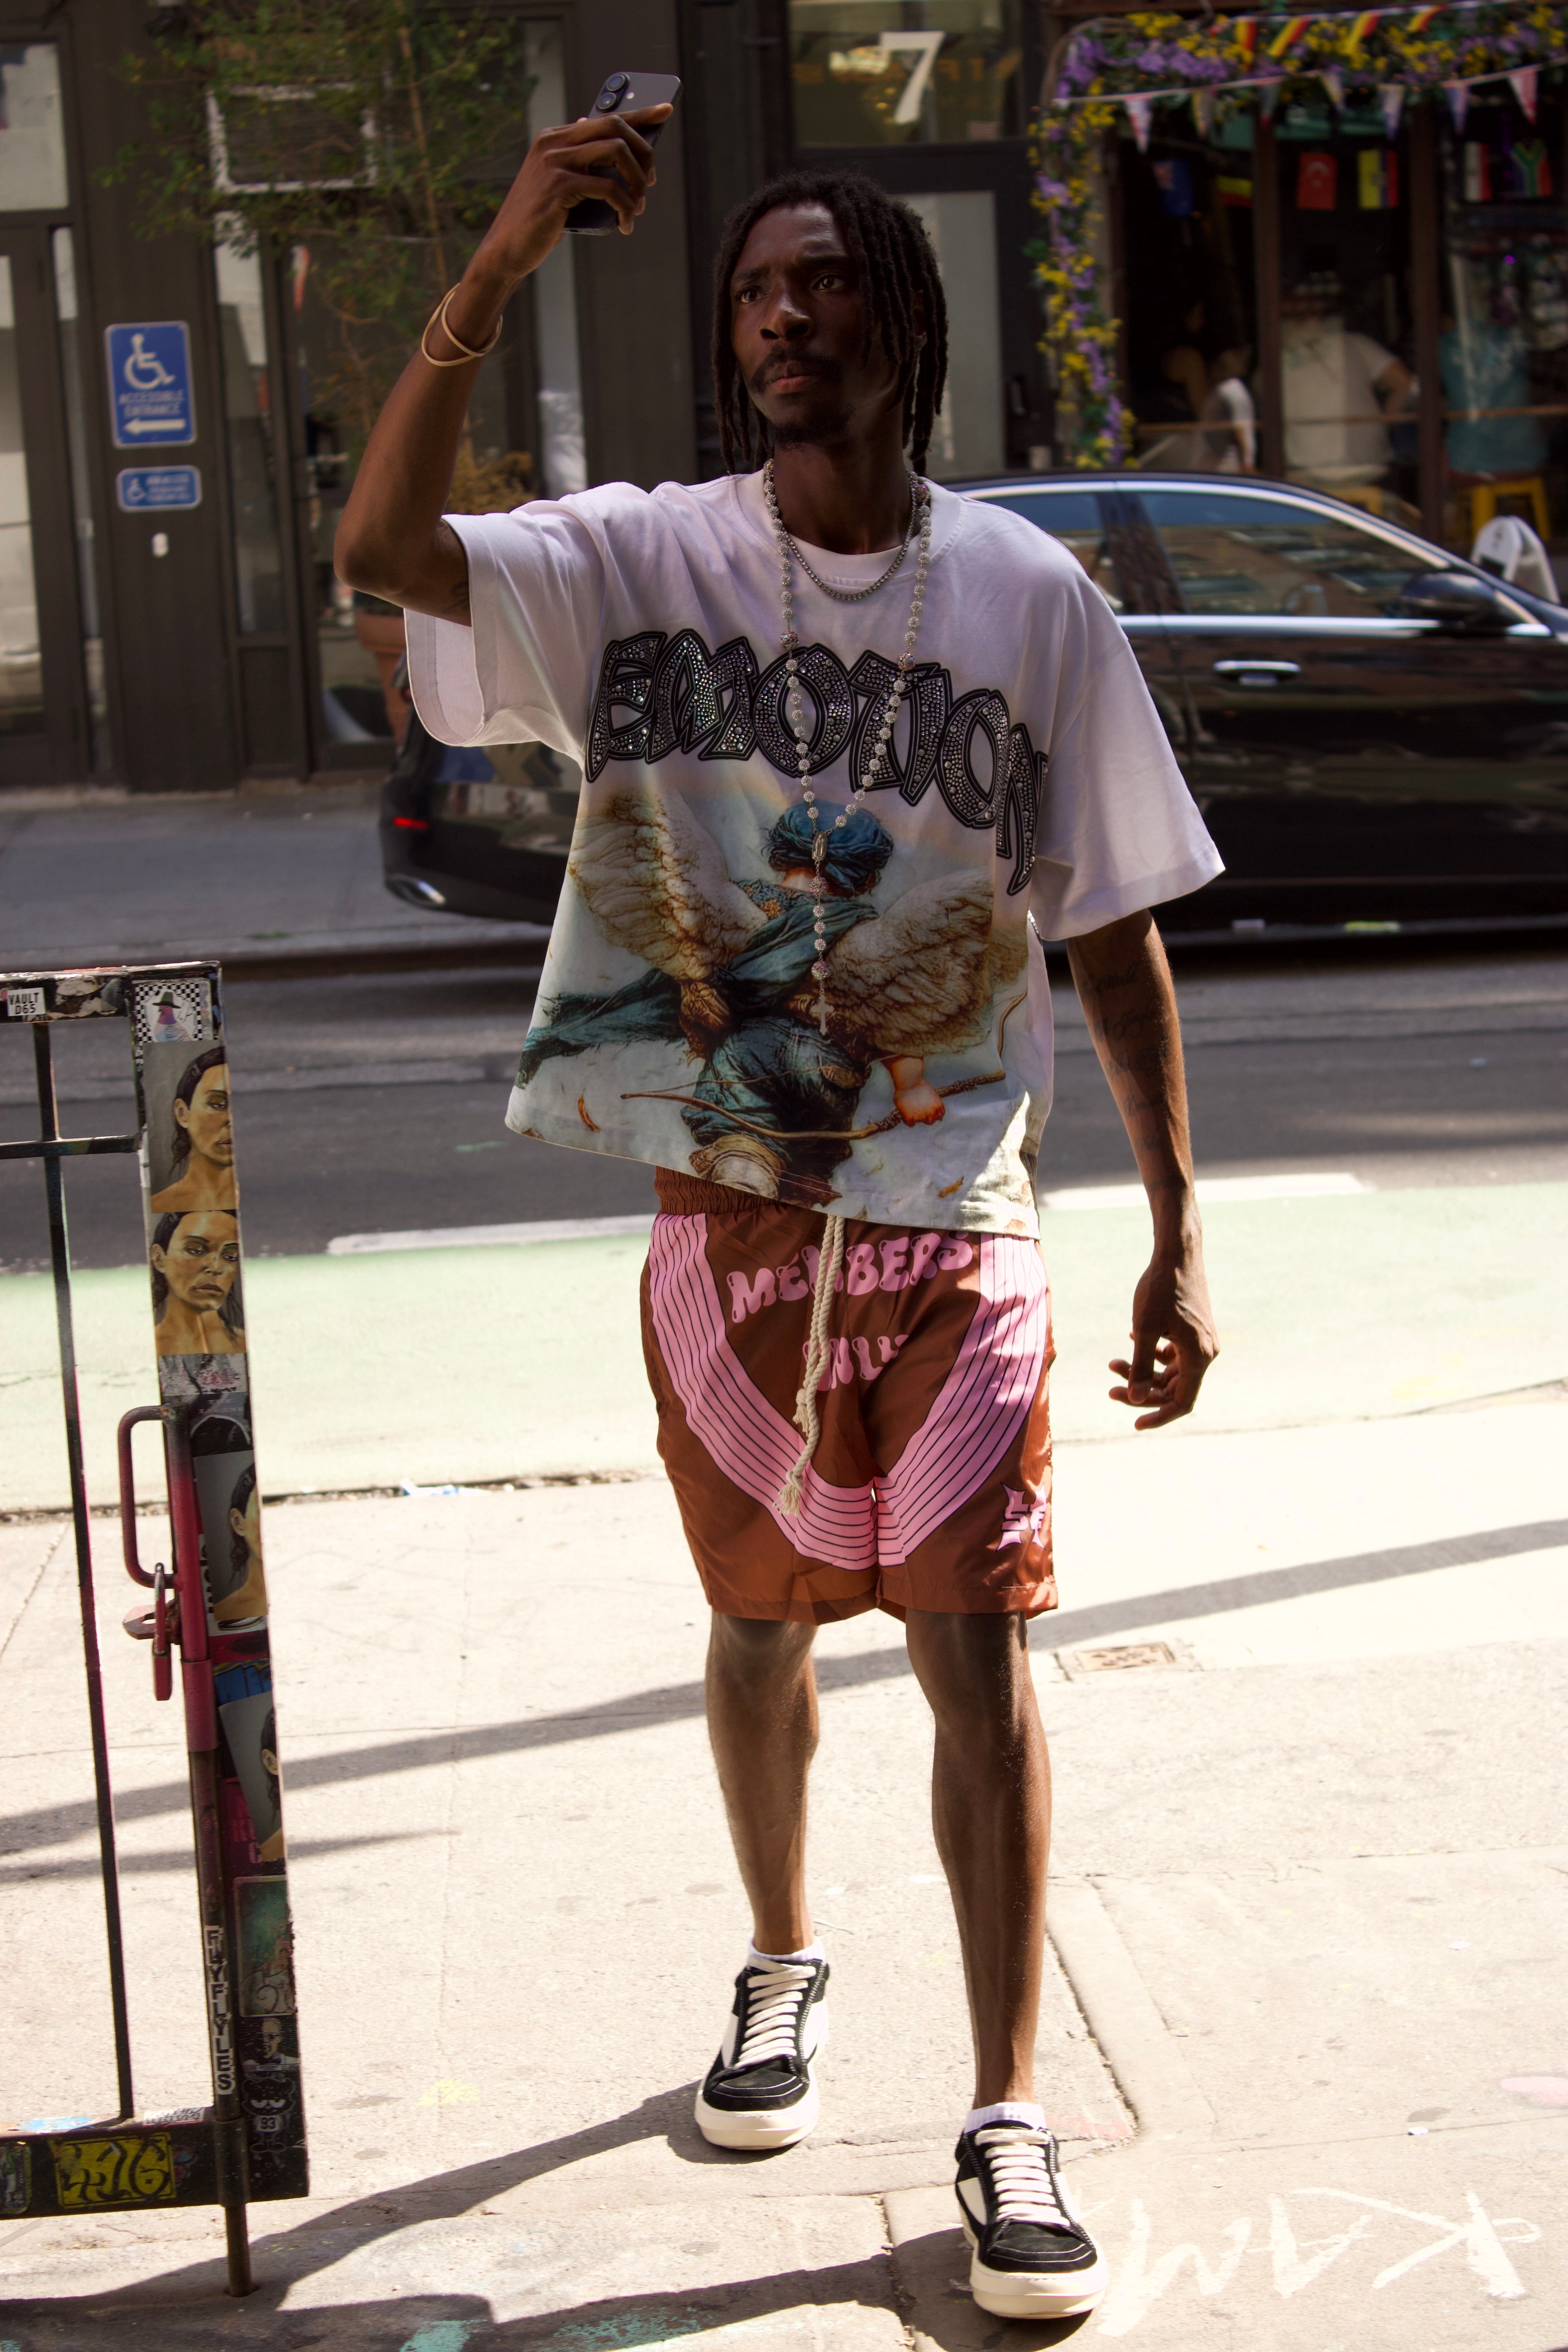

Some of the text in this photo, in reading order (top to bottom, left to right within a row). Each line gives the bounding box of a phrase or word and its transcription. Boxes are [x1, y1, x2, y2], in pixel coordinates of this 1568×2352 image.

[879, 30, 946, 125] 7
[8, 992, 39, 1005] VAULT
[15, 1004, 36, 1014] D65
